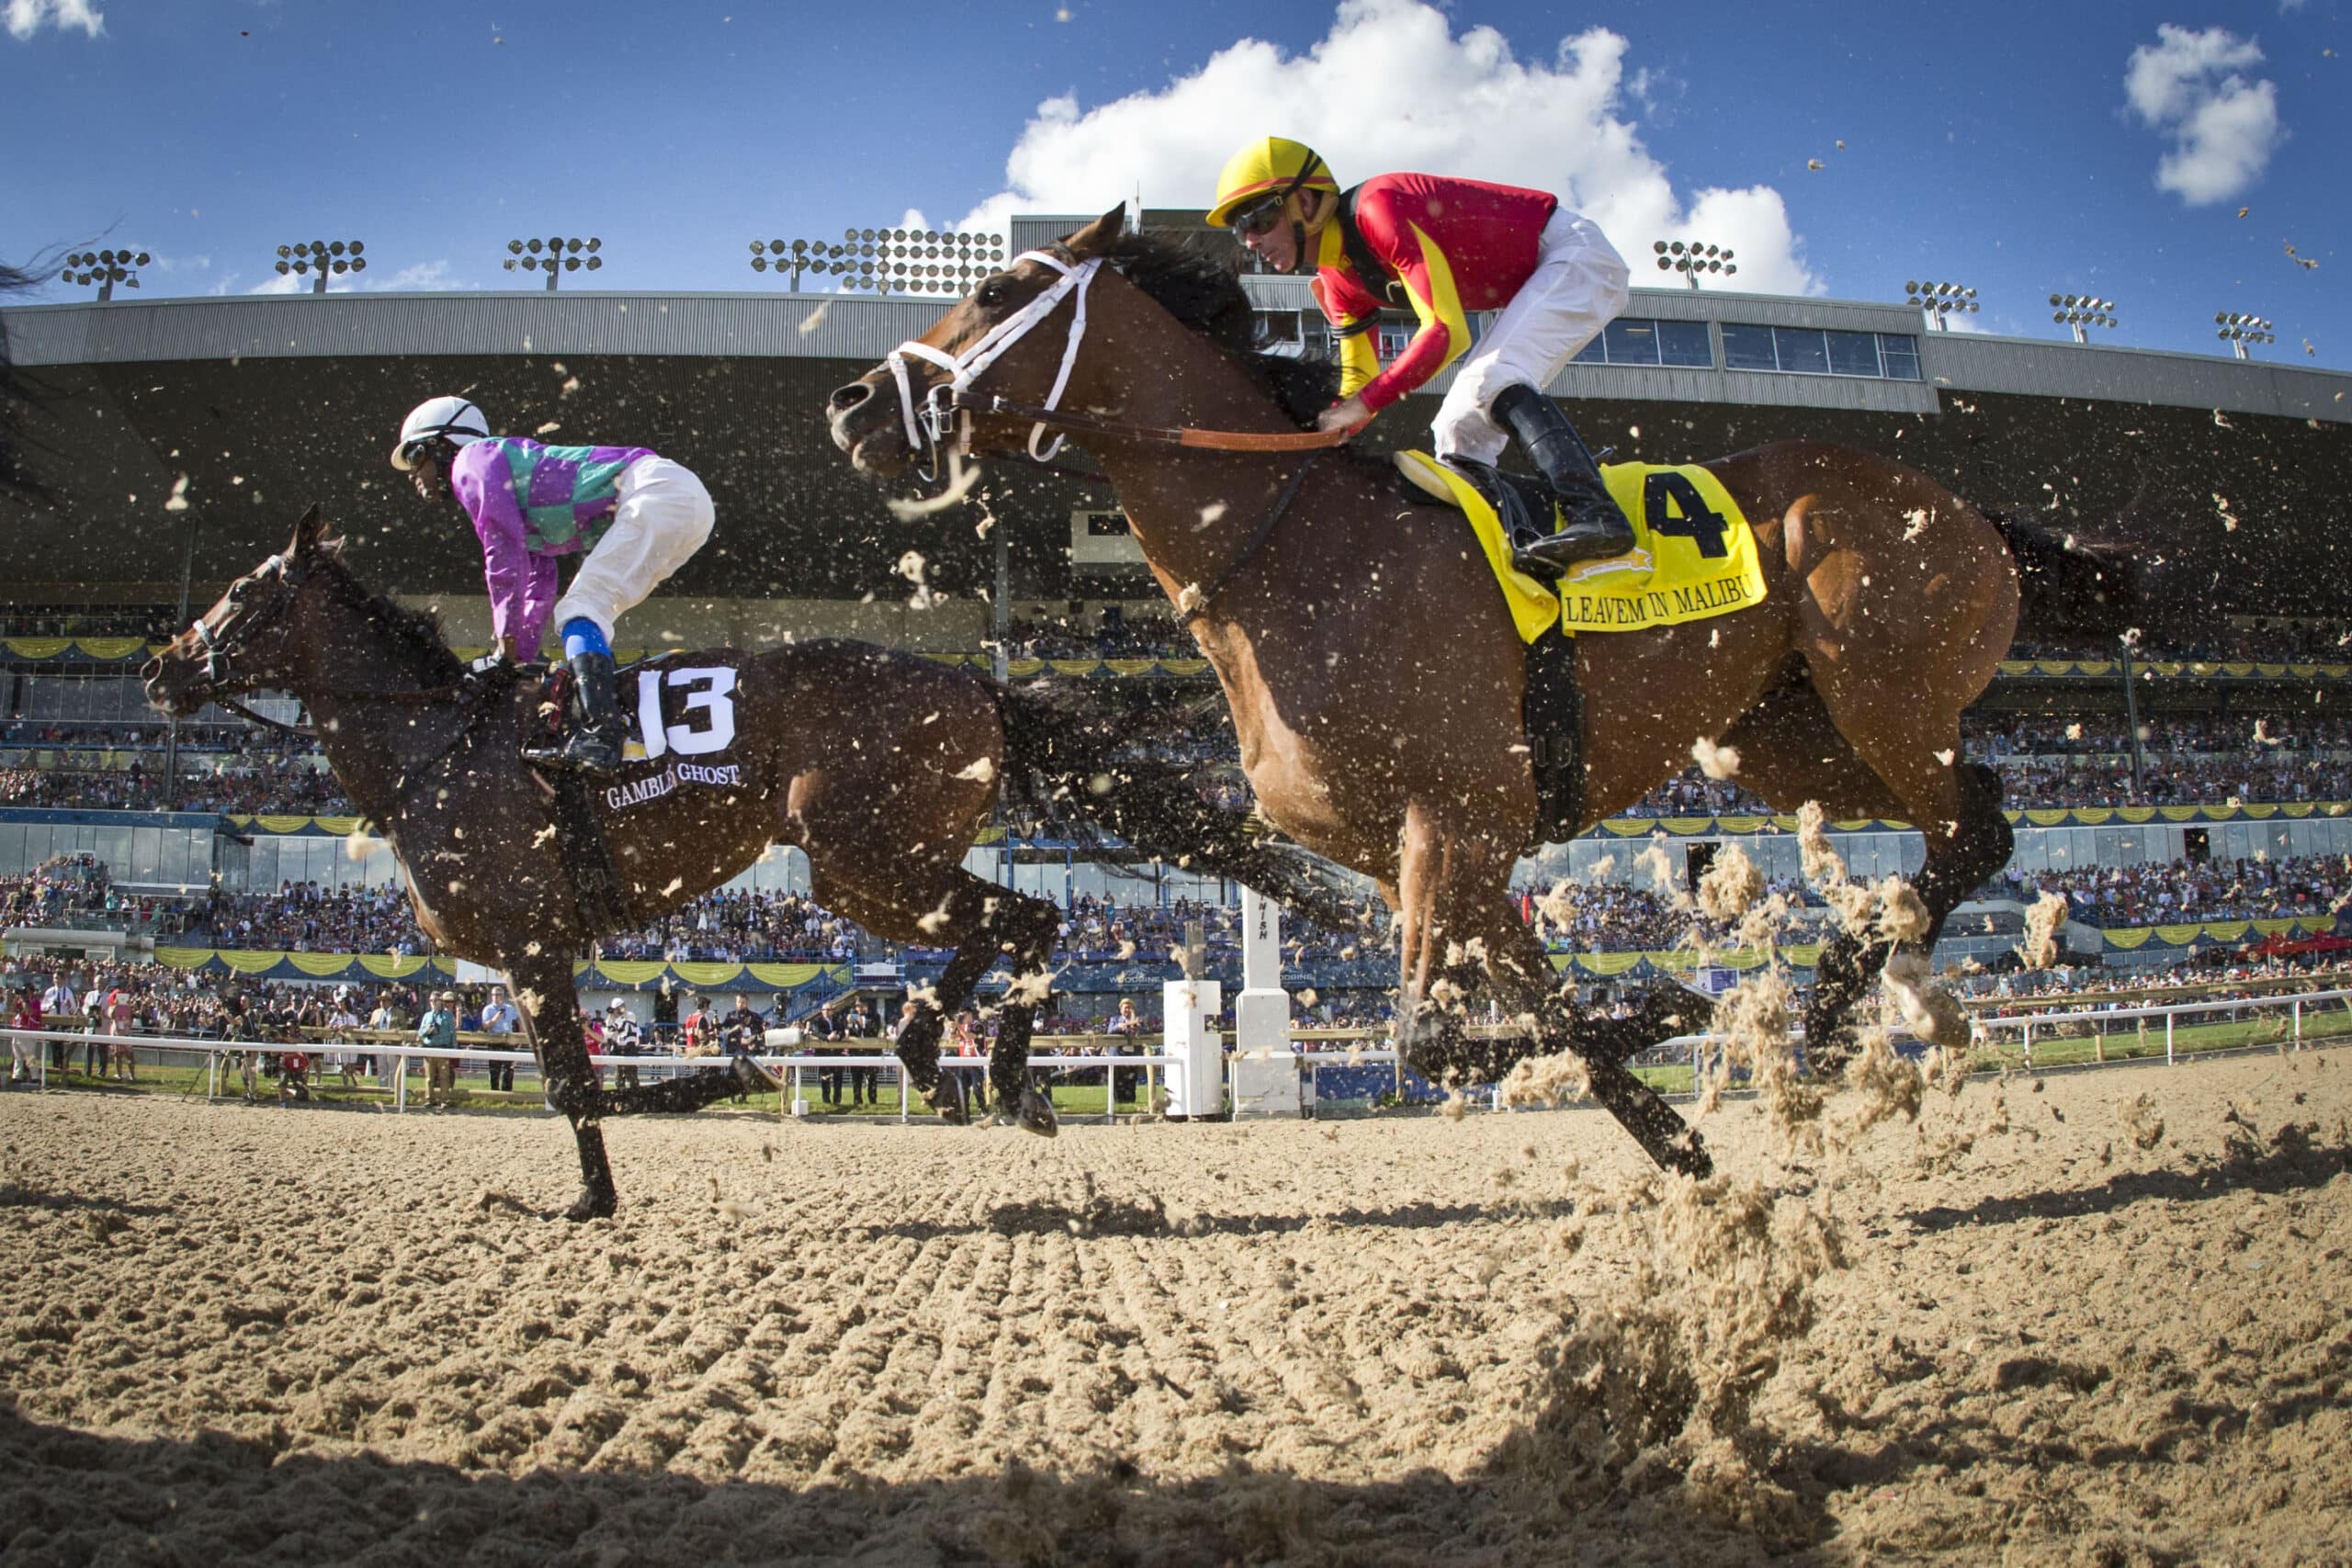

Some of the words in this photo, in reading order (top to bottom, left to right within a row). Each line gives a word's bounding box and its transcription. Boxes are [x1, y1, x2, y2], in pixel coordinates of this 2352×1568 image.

[1645, 472, 1729, 558] 4
[1565, 595, 1647, 625] LEAVEM
[1647, 592, 1668, 617] IN
[1672, 572, 1755, 615] MALIBU
[638, 666, 739, 761] 13
[676, 762, 741, 787] GHOST
[1258, 894, 1268, 941] INISH
[1108, 976, 1161, 985] WODBINE
